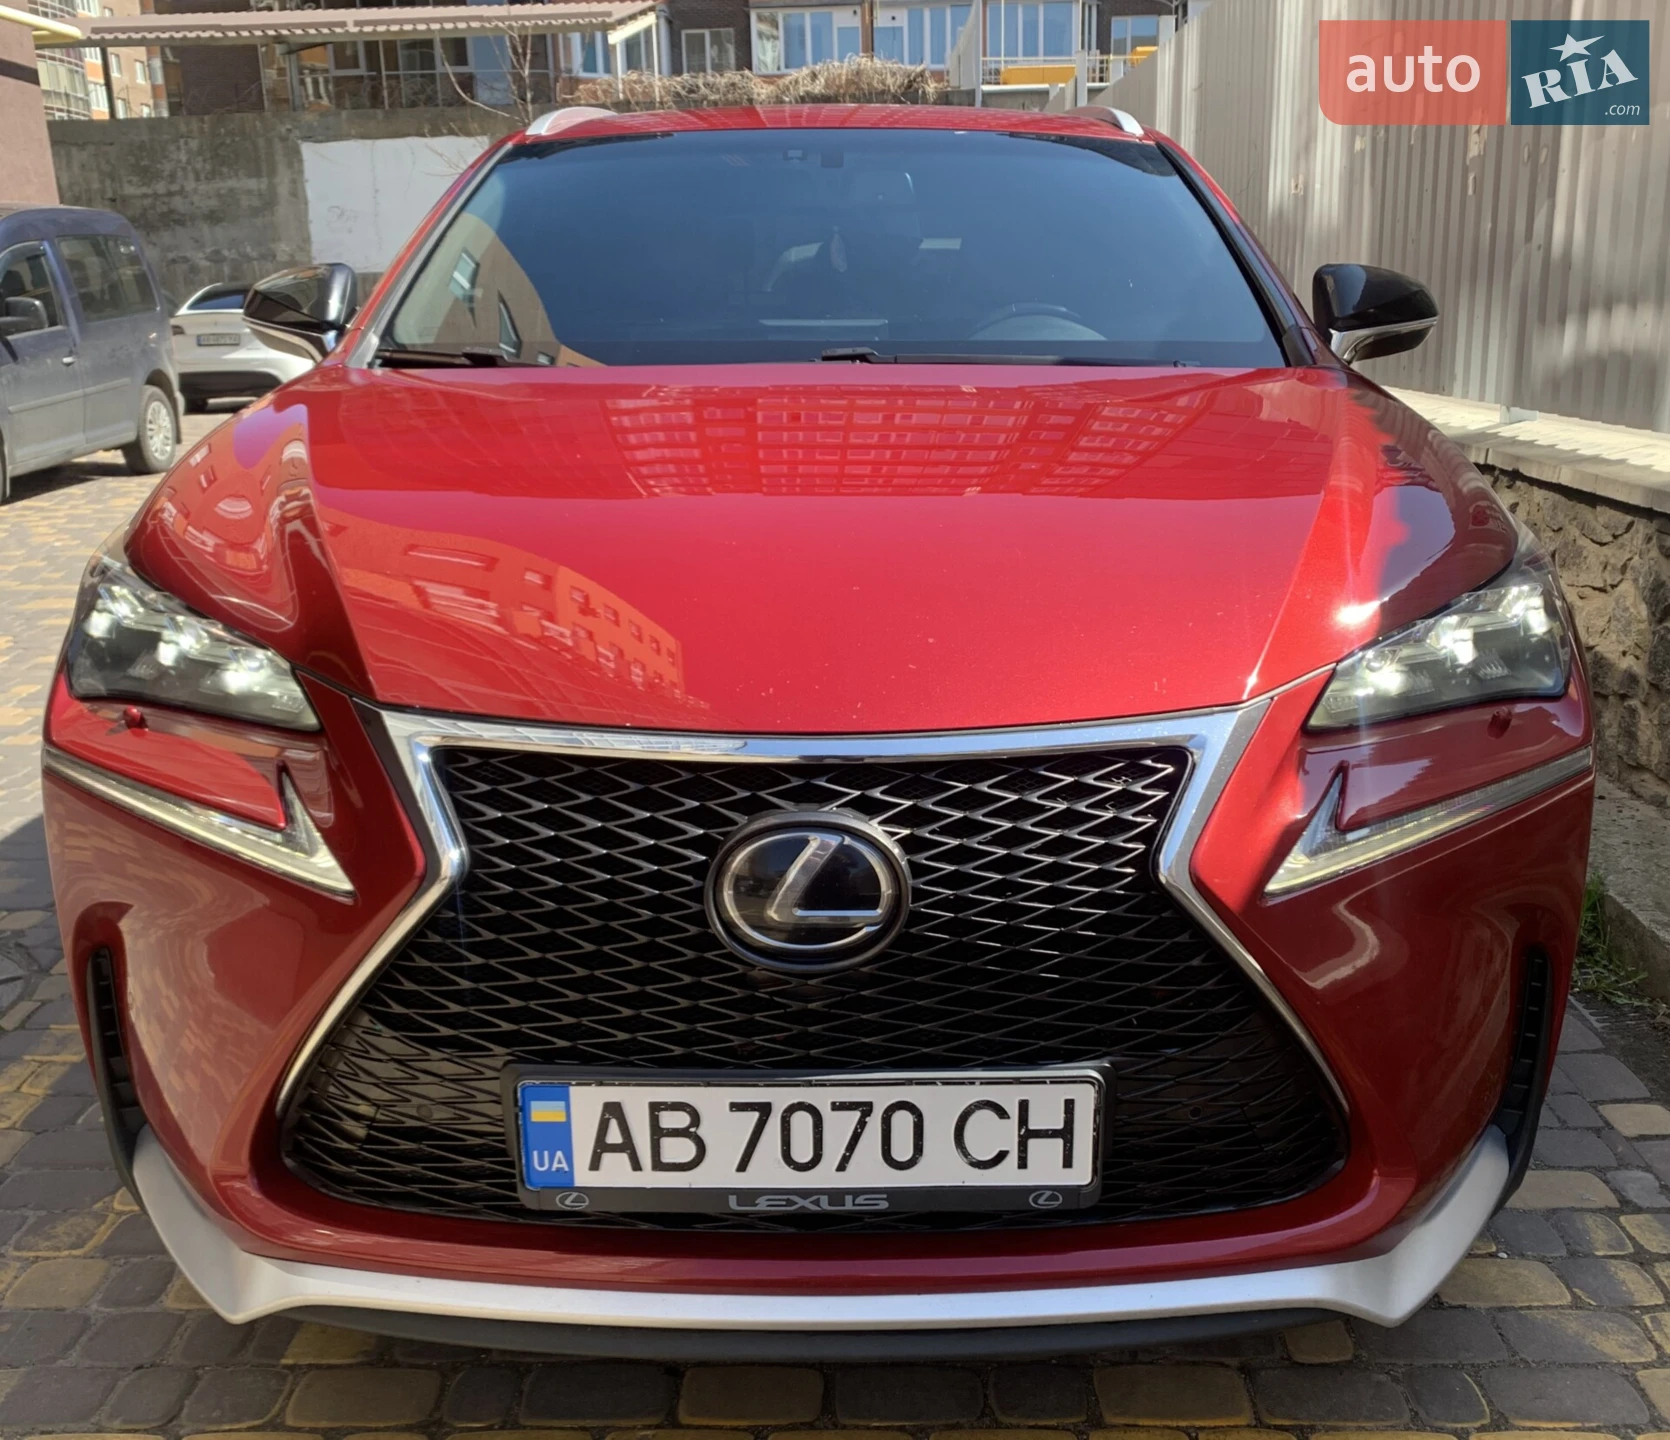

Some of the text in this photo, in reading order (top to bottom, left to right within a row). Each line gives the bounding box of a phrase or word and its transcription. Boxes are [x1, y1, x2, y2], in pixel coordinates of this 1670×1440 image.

[588, 1098, 1076, 1173] AB 7070 CH
[533, 1150, 570, 1172] UA
[728, 1194, 890, 1211] LEXUS
